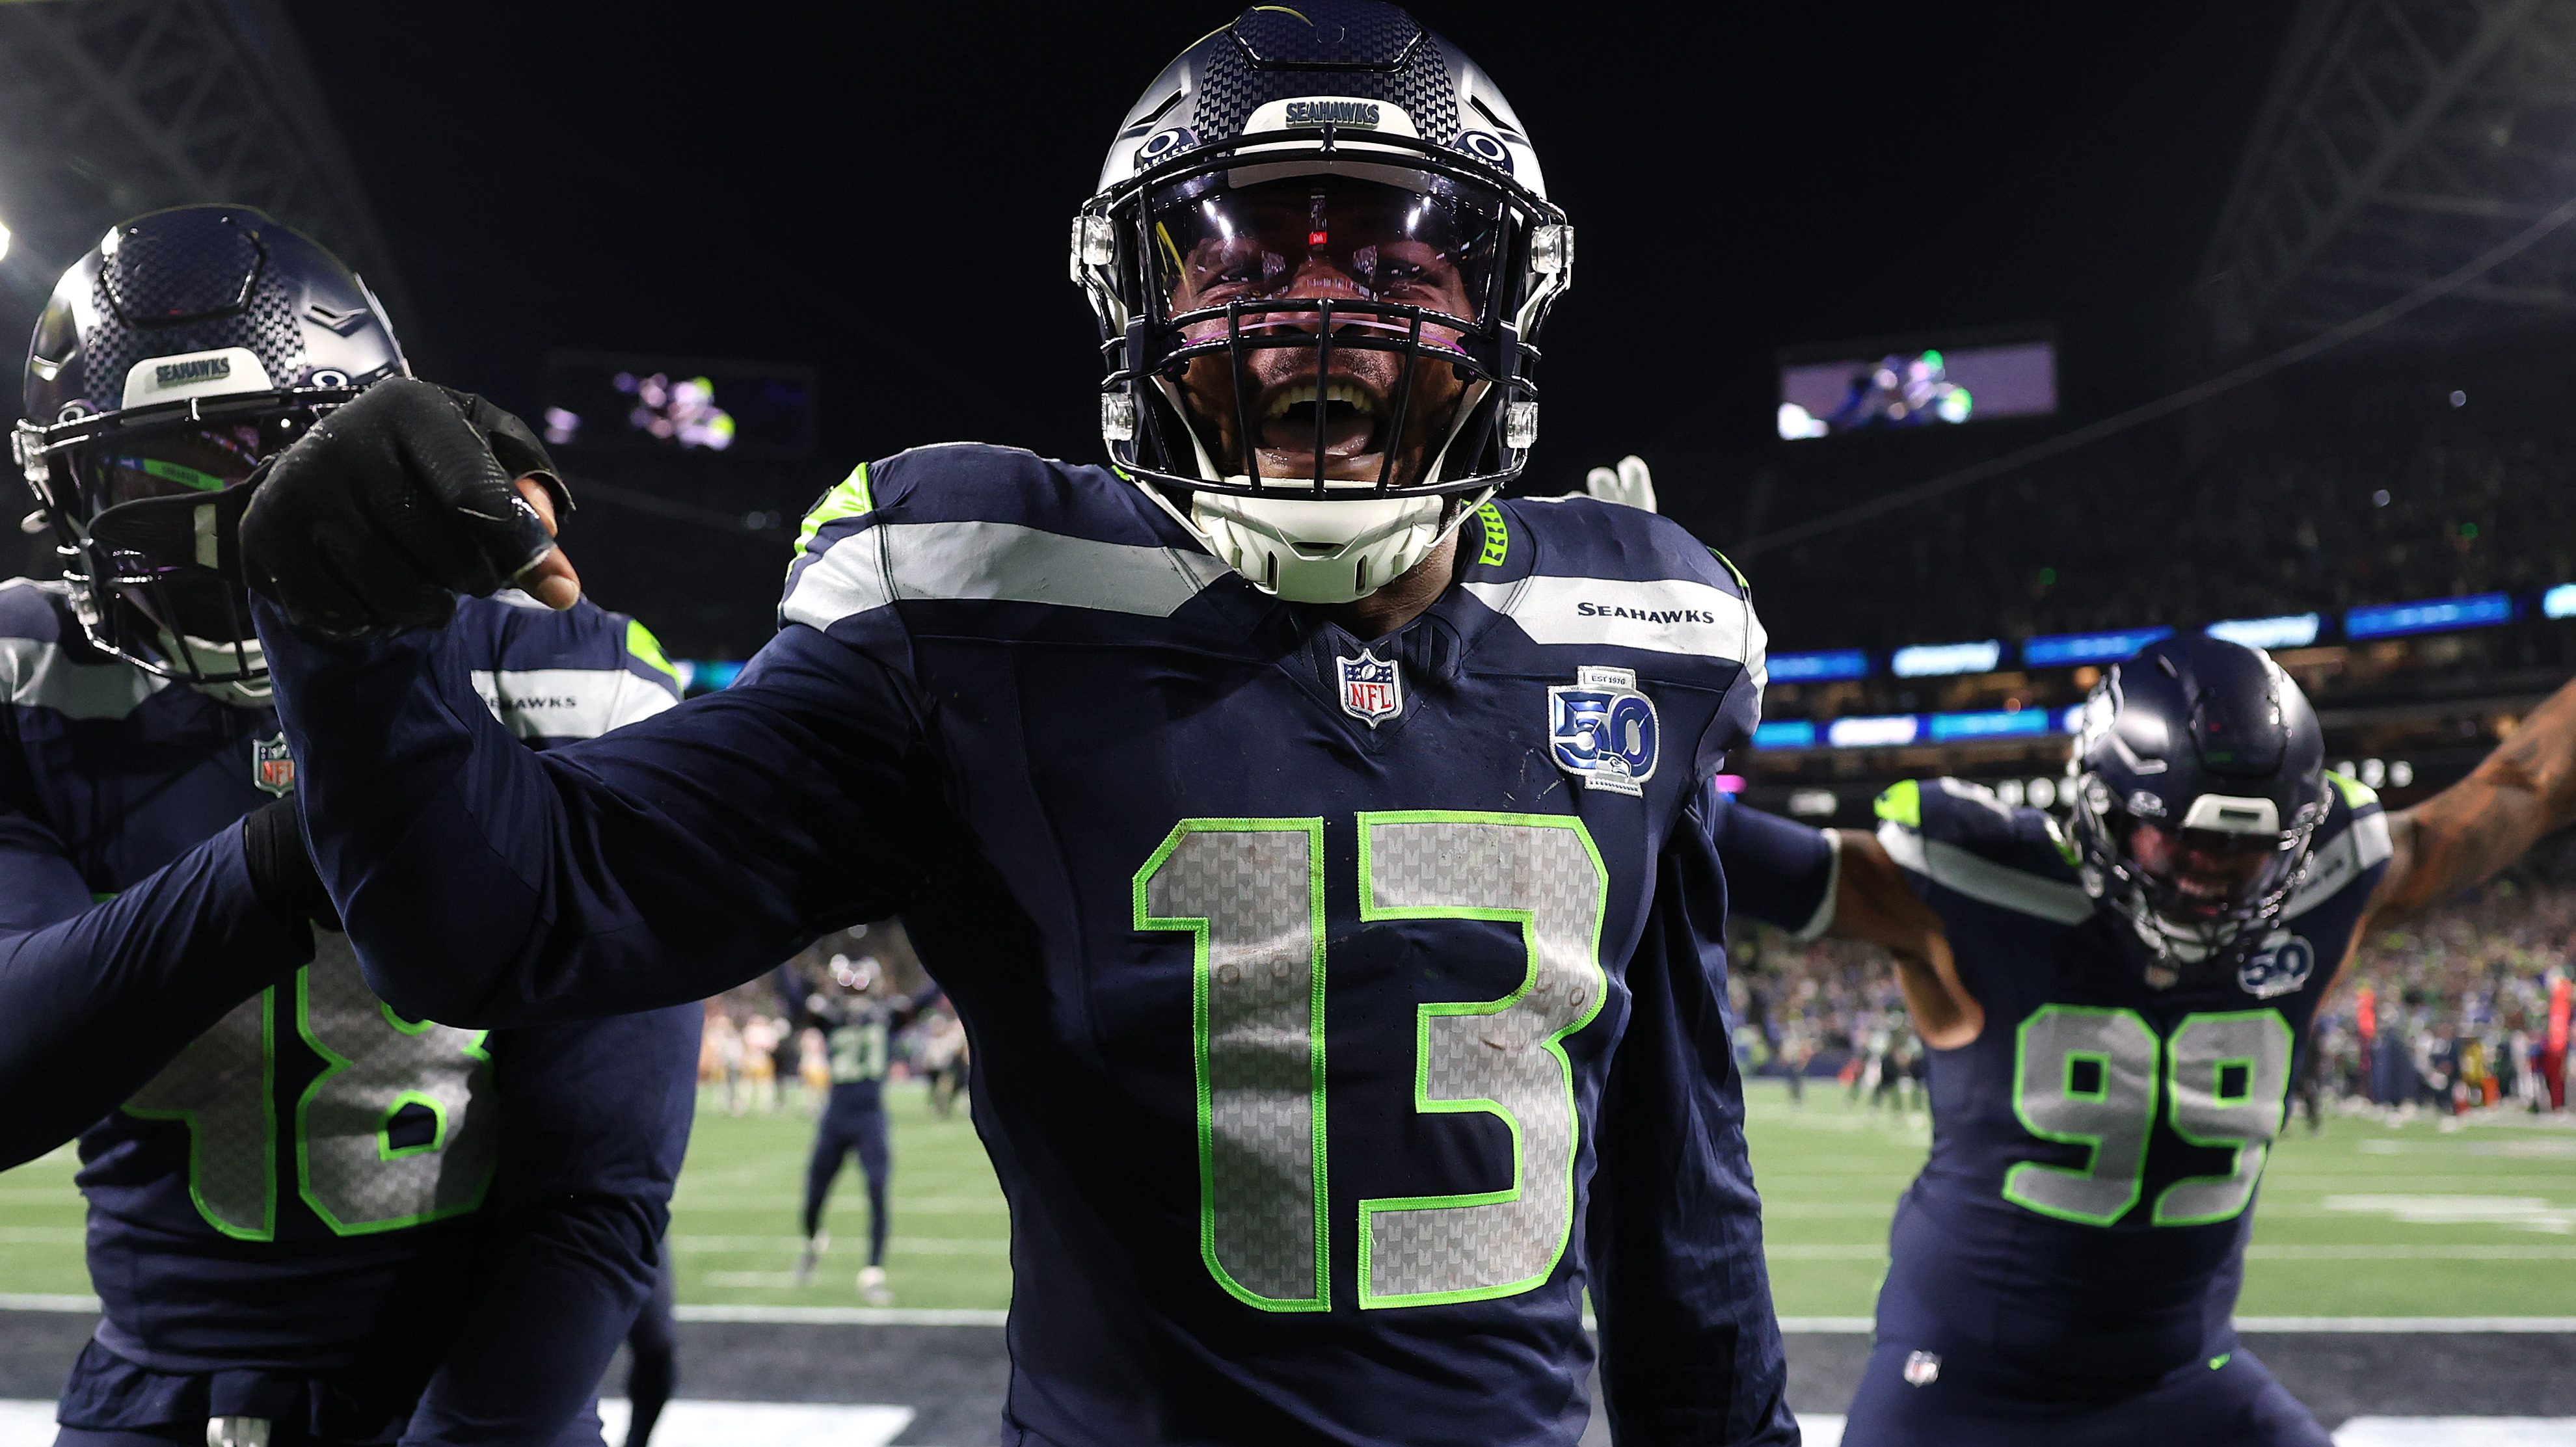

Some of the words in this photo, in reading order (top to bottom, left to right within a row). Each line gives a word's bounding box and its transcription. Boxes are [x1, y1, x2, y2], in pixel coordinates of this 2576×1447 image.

[1286, 101, 1380, 124] SEAHAWKS
[156, 357, 230, 382] SEAHAWKS
[1577, 602, 1715, 624] SEAHAWKS
[1609, 676, 1626, 685] 1976
[1350, 683, 1392, 711] NFL
[1555, 691, 1656, 777] 50
[263, 760, 294, 786] NFL
[2243, 944, 2307, 985] 50
[828, 1024, 887, 1084] 21
[1133, 810, 1609, 1312] 13
[2002, 1002, 2294, 1227] 99
